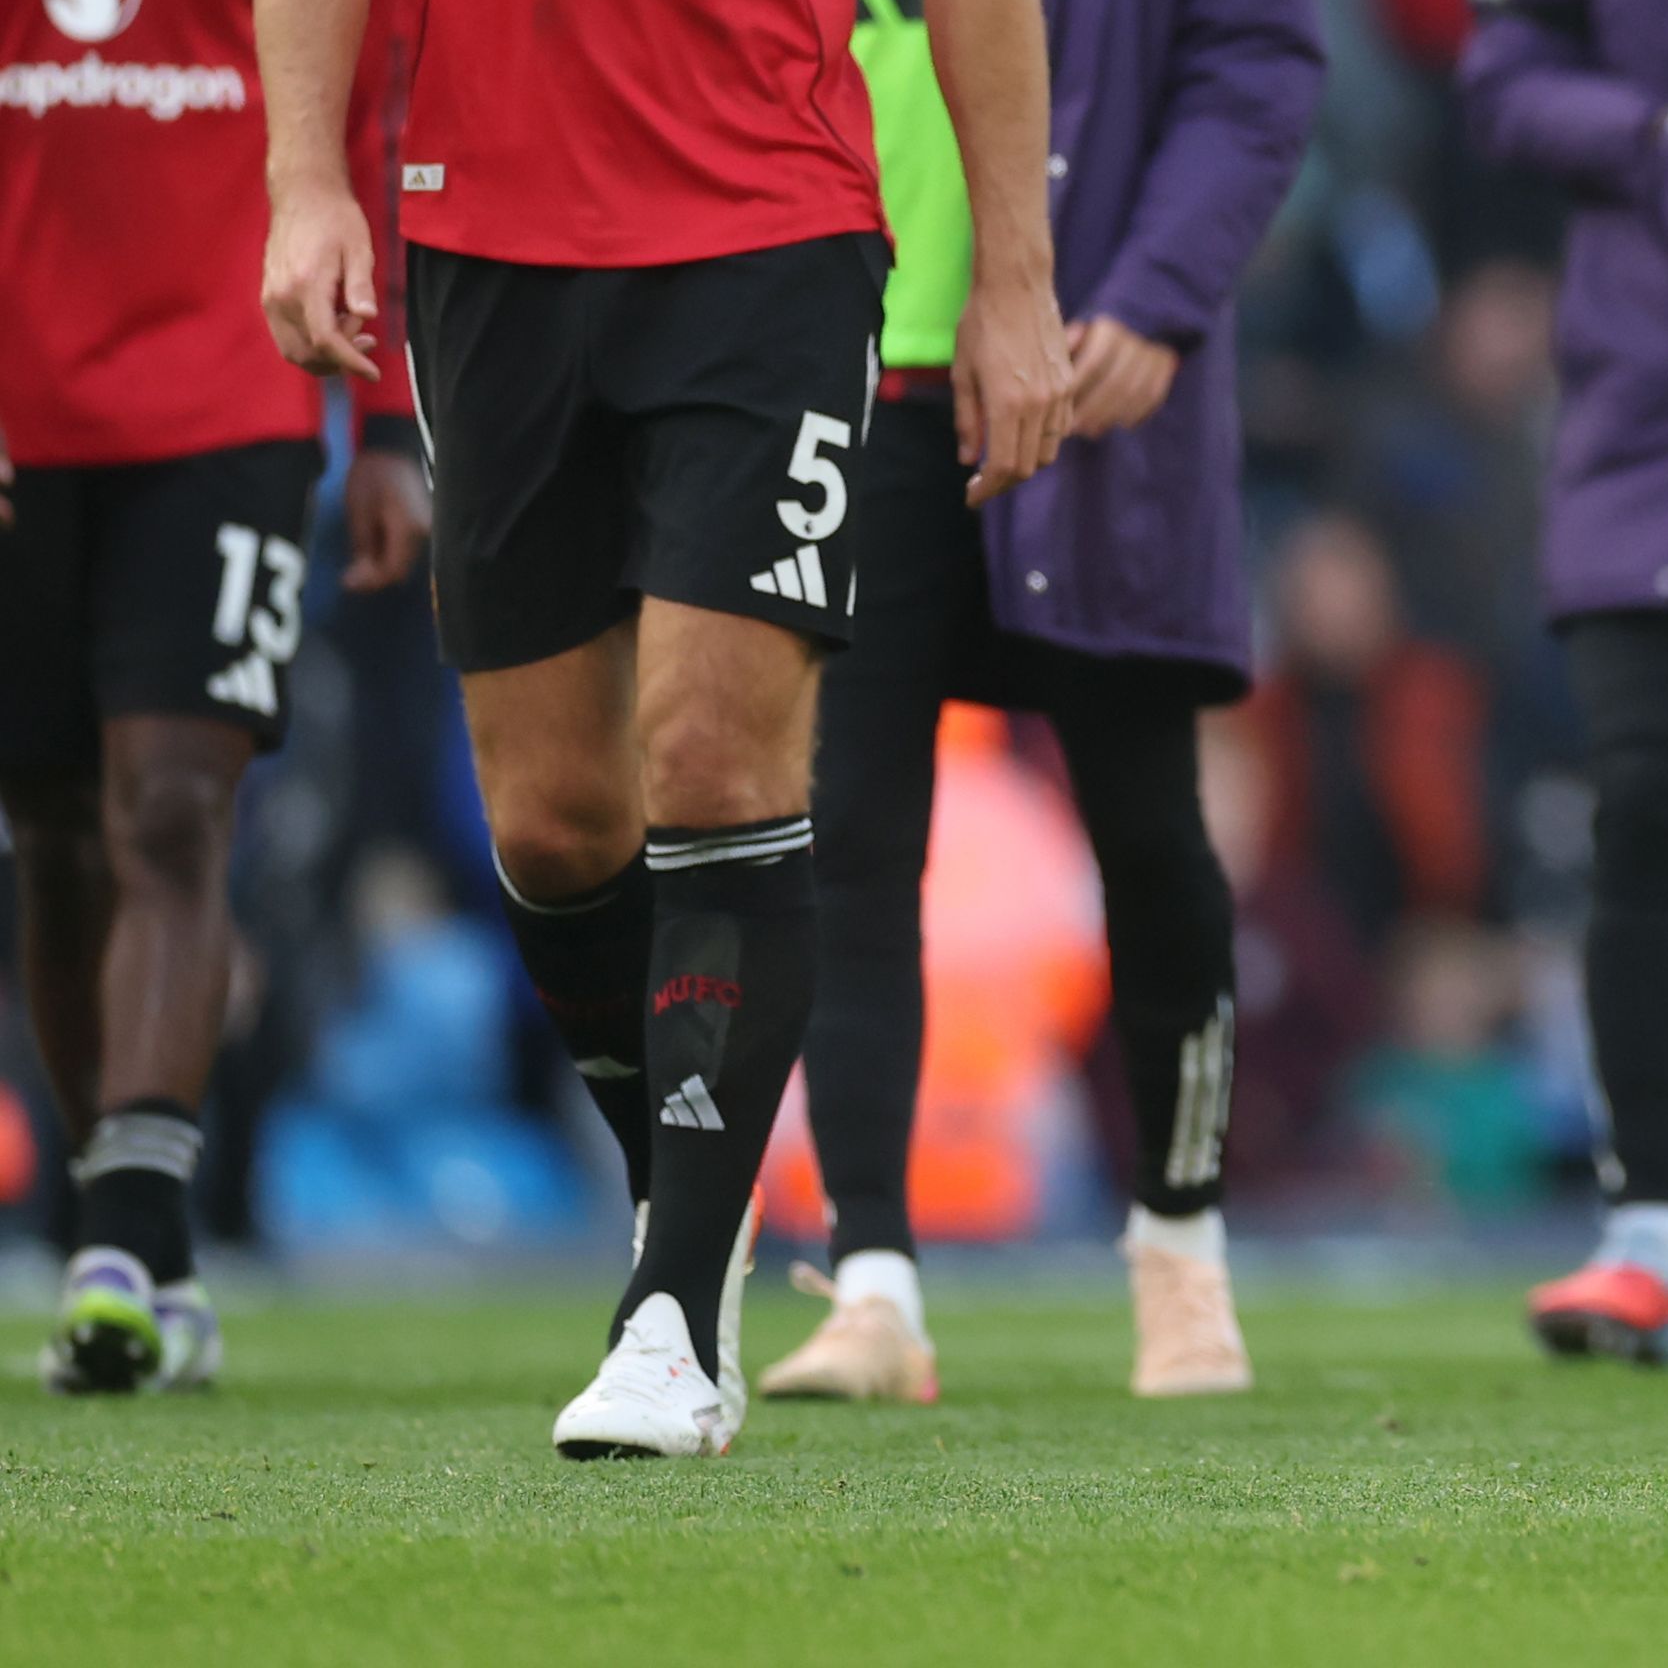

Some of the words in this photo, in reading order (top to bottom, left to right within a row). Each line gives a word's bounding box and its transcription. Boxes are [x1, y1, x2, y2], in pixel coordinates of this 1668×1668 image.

[0, 48, 246, 120] apdragon
[776, 411, 851, 540] 5
[212, 521, 306, 664] 13
[654, 973, 743, 1016] MUFC
